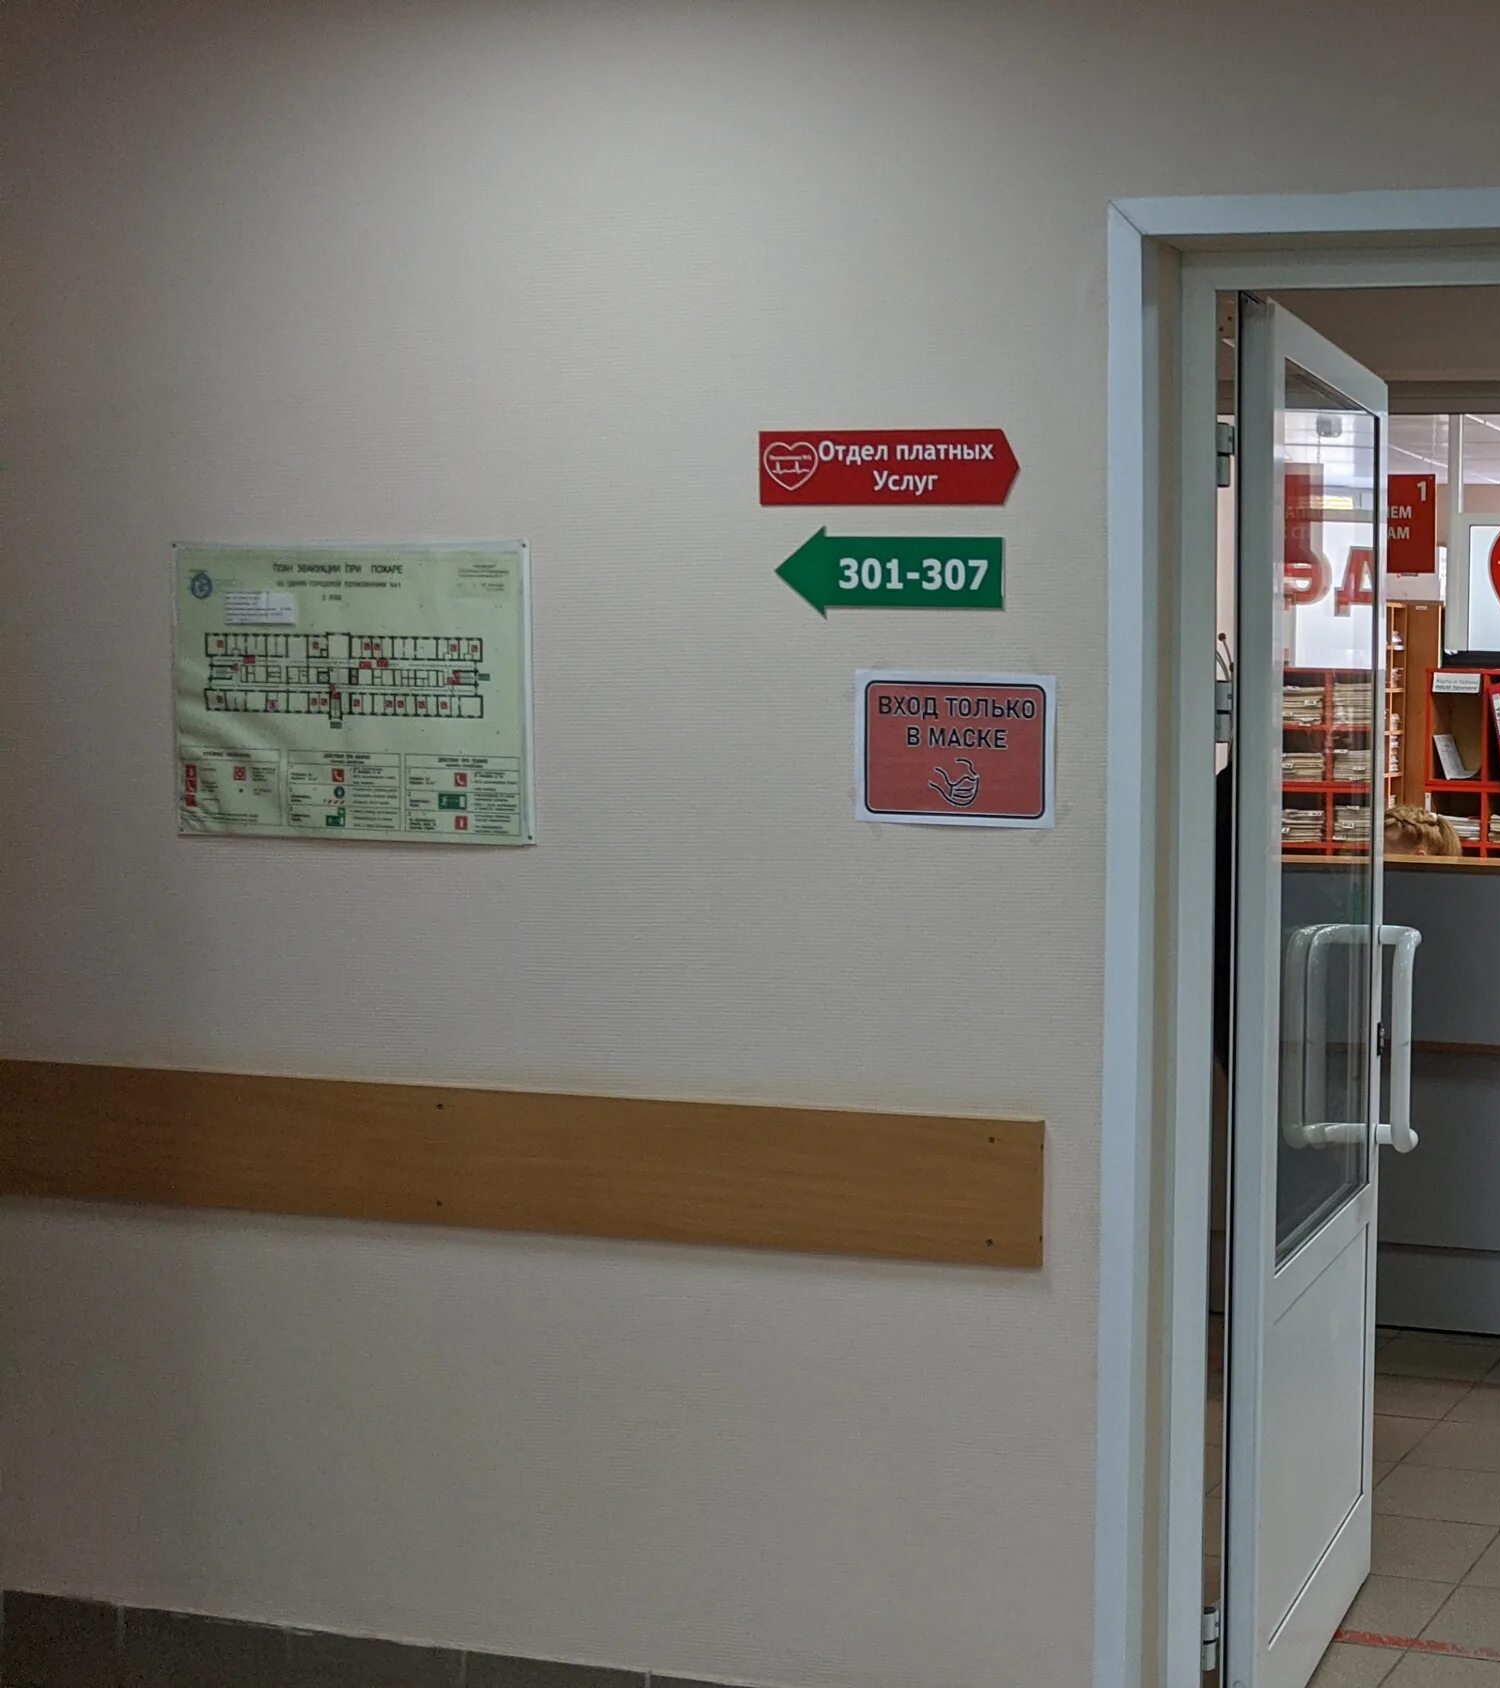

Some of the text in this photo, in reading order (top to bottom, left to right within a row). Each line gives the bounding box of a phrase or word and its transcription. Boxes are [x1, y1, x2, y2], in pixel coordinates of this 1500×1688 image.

[818, 440, 994, 466] Отдел платных
[873, 470, 939, 496] Услуг
[1416, 481, 1427, 501] 1
[838, 557, 989, 591] 301-307
[878, 695, 1036, 720] ВХОД ТОЛЬКО
[907, 727, 1008, 749] В МАСКЕ
